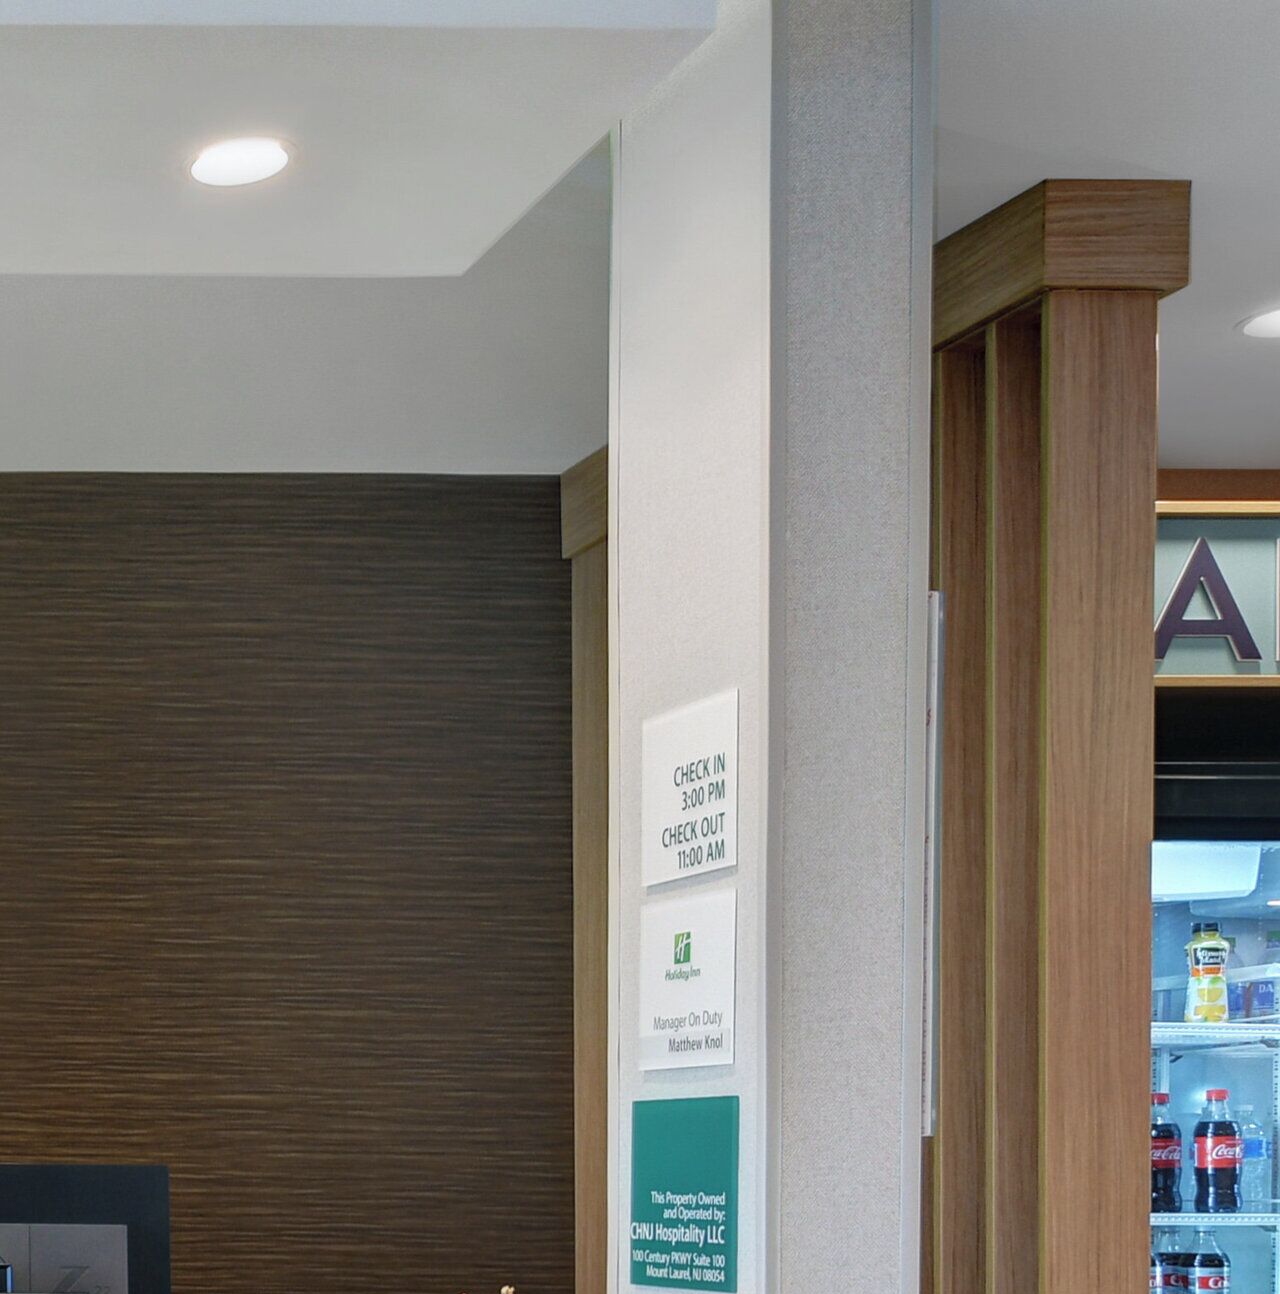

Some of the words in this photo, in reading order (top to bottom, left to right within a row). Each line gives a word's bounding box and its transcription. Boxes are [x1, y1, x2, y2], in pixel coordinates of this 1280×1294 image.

[1154, 536, 1280, 662] A
[674, 756, 710, 787] CHECK
[714, 752, 725, 775] IN
[681, 786, 704, 811] 3:00
[708, 779, 725, 804] PM
[662, 819, 698, 848] CHECK
[701, 812, 725, 838] OUT
[677, 845, 703, 870] 11:00
[706, 839, 725, 863] AM
[665, 967, 690, 981] Holiday
[653, 1017, 686, 1032] Manager
[688, 1012, 701, 1027] On
[702, 1010, 723, 1028] Duty
[668, 1036, 703, 1053] Matthew
[651, 1191, 665, 1204] This
[666, 1192, 697, 1207] Property
[698, 1192, 725, 1206] Owned
[663, 1206, 677, 1219] and
[678, 1207, 713, 1222] Operated
[714, 1207, 725, 1224] by:
[630, 1222, 653, 1240] CHNJ
[656, 1223, 705, 1247] Hospitality
[707, 1225, 726, 1244] LLC
[632, 1249, 644, 1262] 100
[644, 1250, 670, 1266] Century
[671, 1251, 692, 1265] PKWY
[693, 1253, 711, 1266] Suite
[712, 1254, 726, 1268] 100
[646, 1264, 669, 1278] Mount
[692, 1268, 702, 1280] NJ
[702, 1268, 725, 1283] 08054
